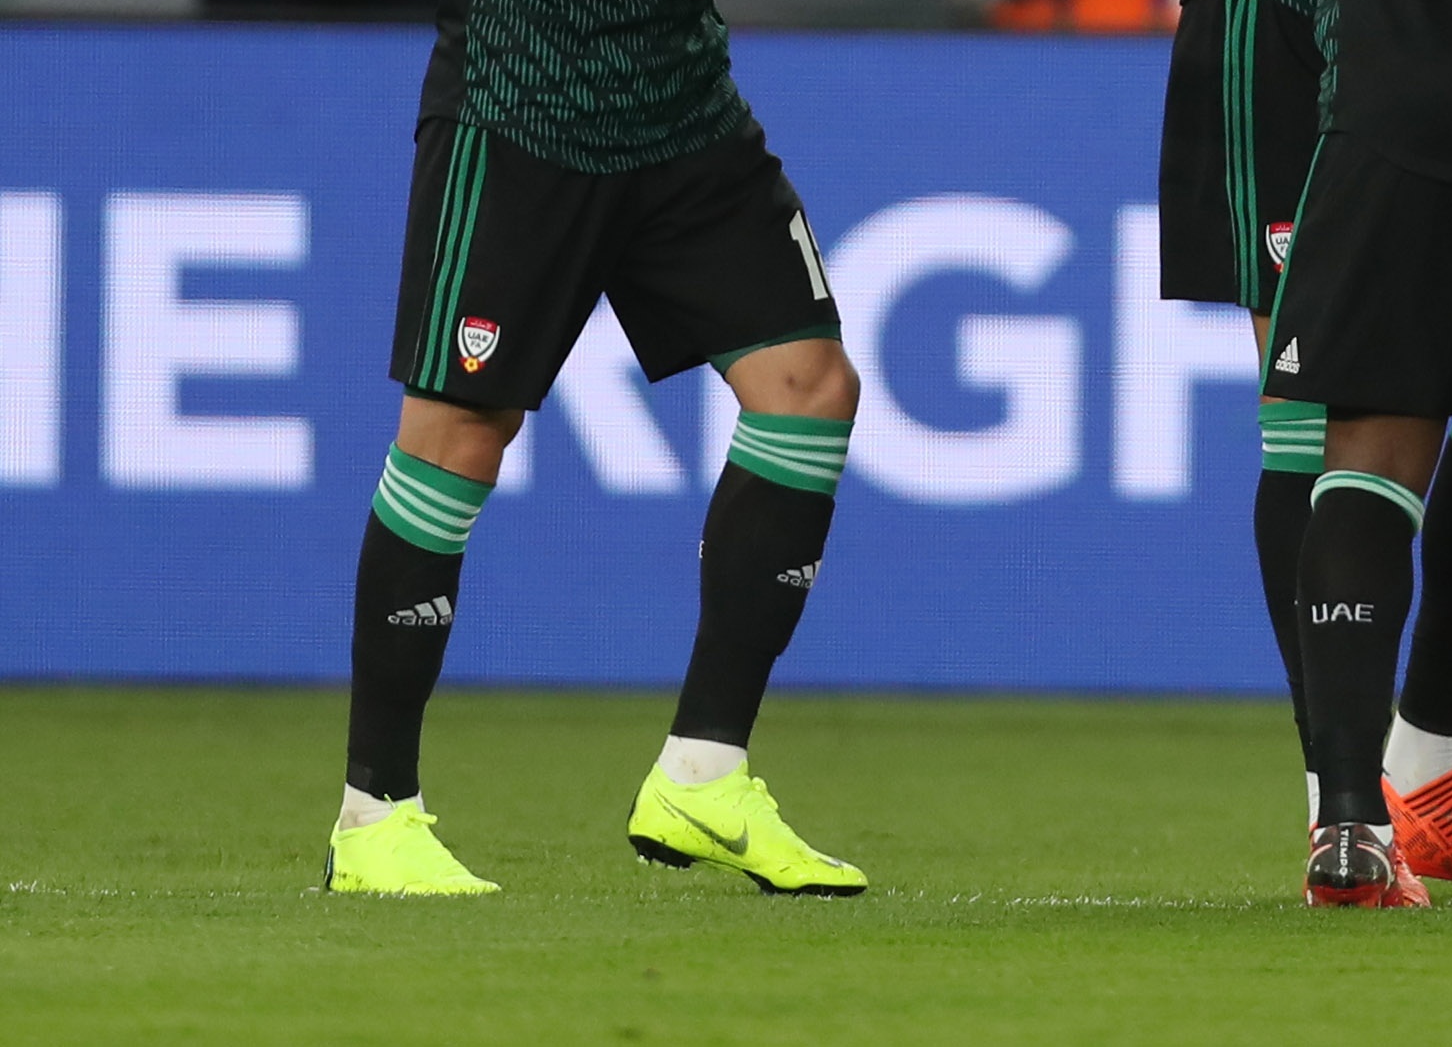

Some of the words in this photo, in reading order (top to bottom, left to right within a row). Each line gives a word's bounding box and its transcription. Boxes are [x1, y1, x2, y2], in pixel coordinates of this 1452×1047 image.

[789, 209, 833, 300] 1
[467, 332, 488, 343] UAE
[776, 573, 813, 589] adid
[1311, 602, 1375, 624] UAE
[1339, 828, 1350, 876] TIEMPO
